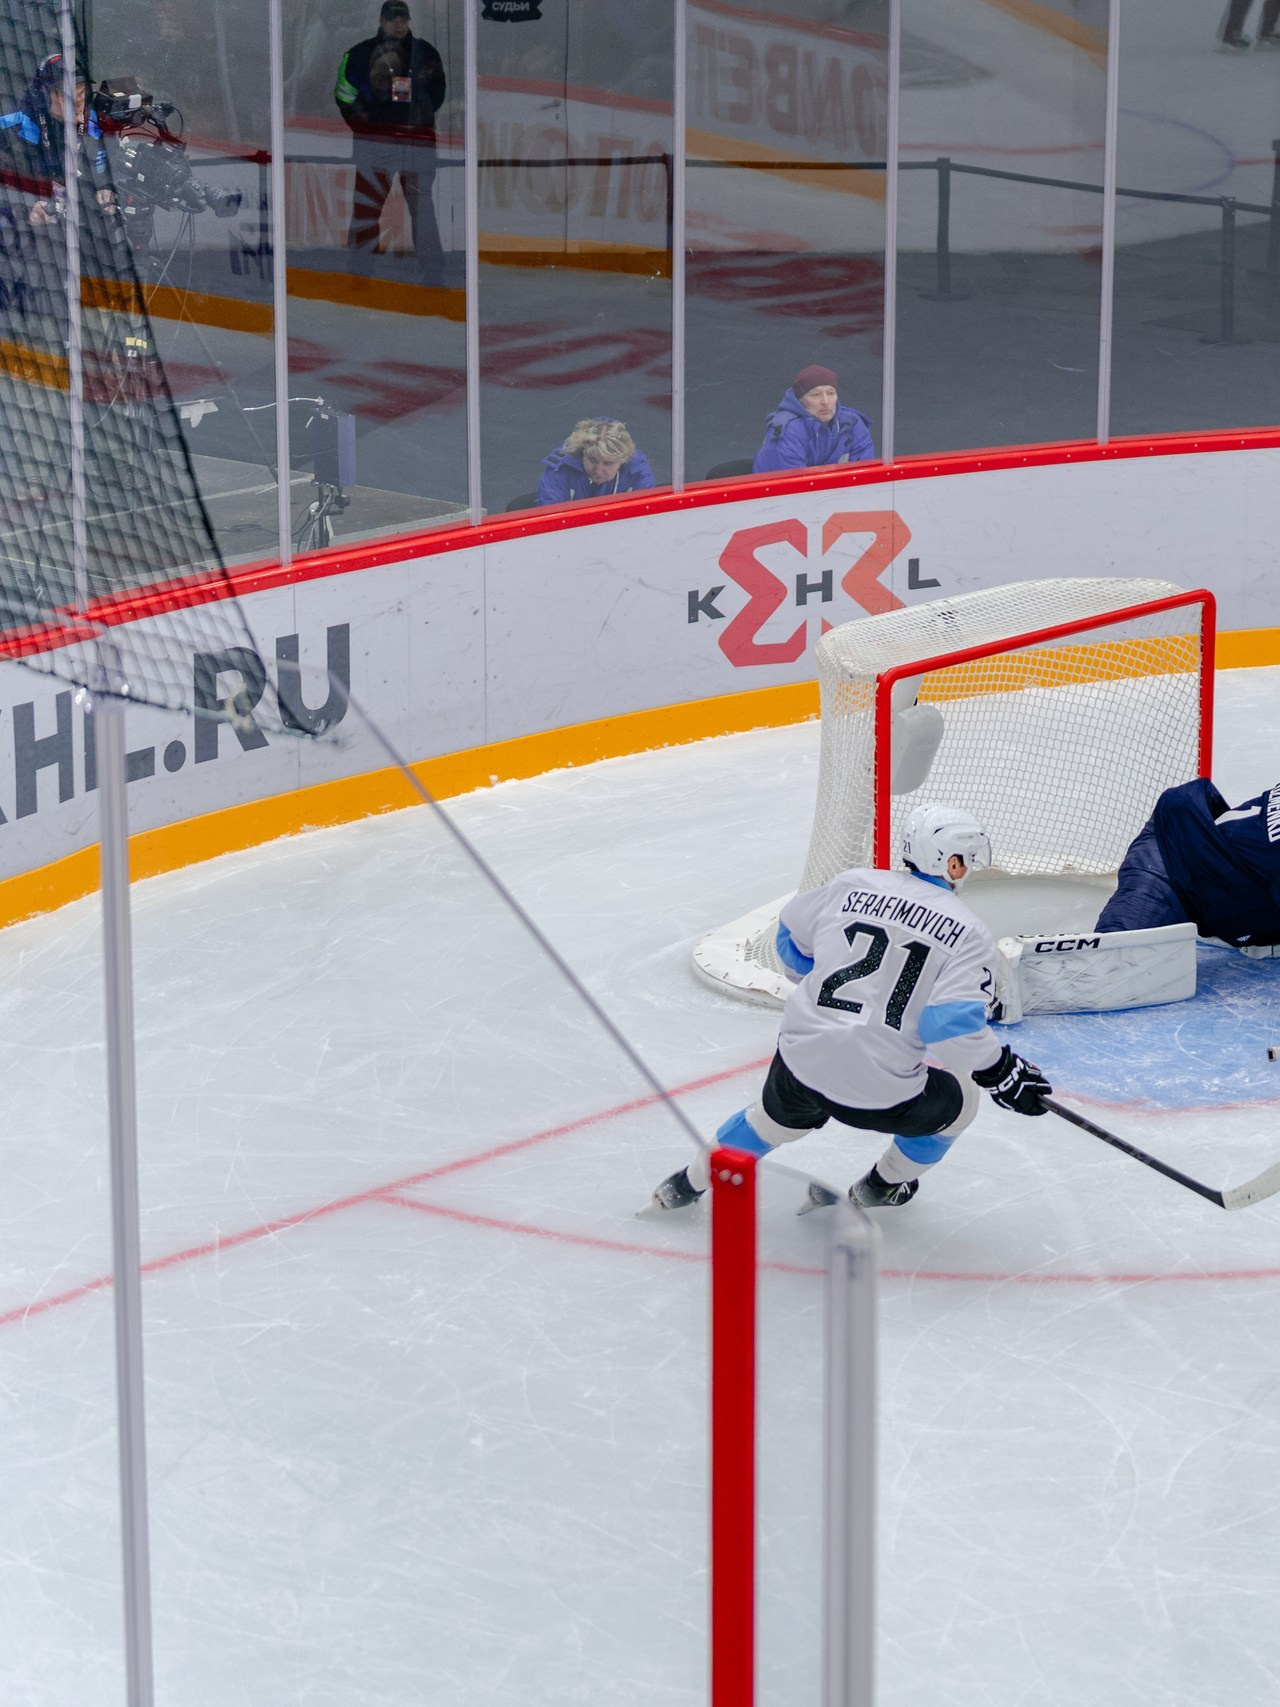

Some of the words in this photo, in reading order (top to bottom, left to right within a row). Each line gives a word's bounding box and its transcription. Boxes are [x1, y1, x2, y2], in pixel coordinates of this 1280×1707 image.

[492, 1, 530, 13] СУДЬИ
[0, 623, 350, 825] HL.RU
[903, 838, 911, 855] 21
[842, 891, 966, 948] SERAFIMOVICH
[1034, 937, 1101, 953] CCM
[817, 921, 931, 1031] 21
